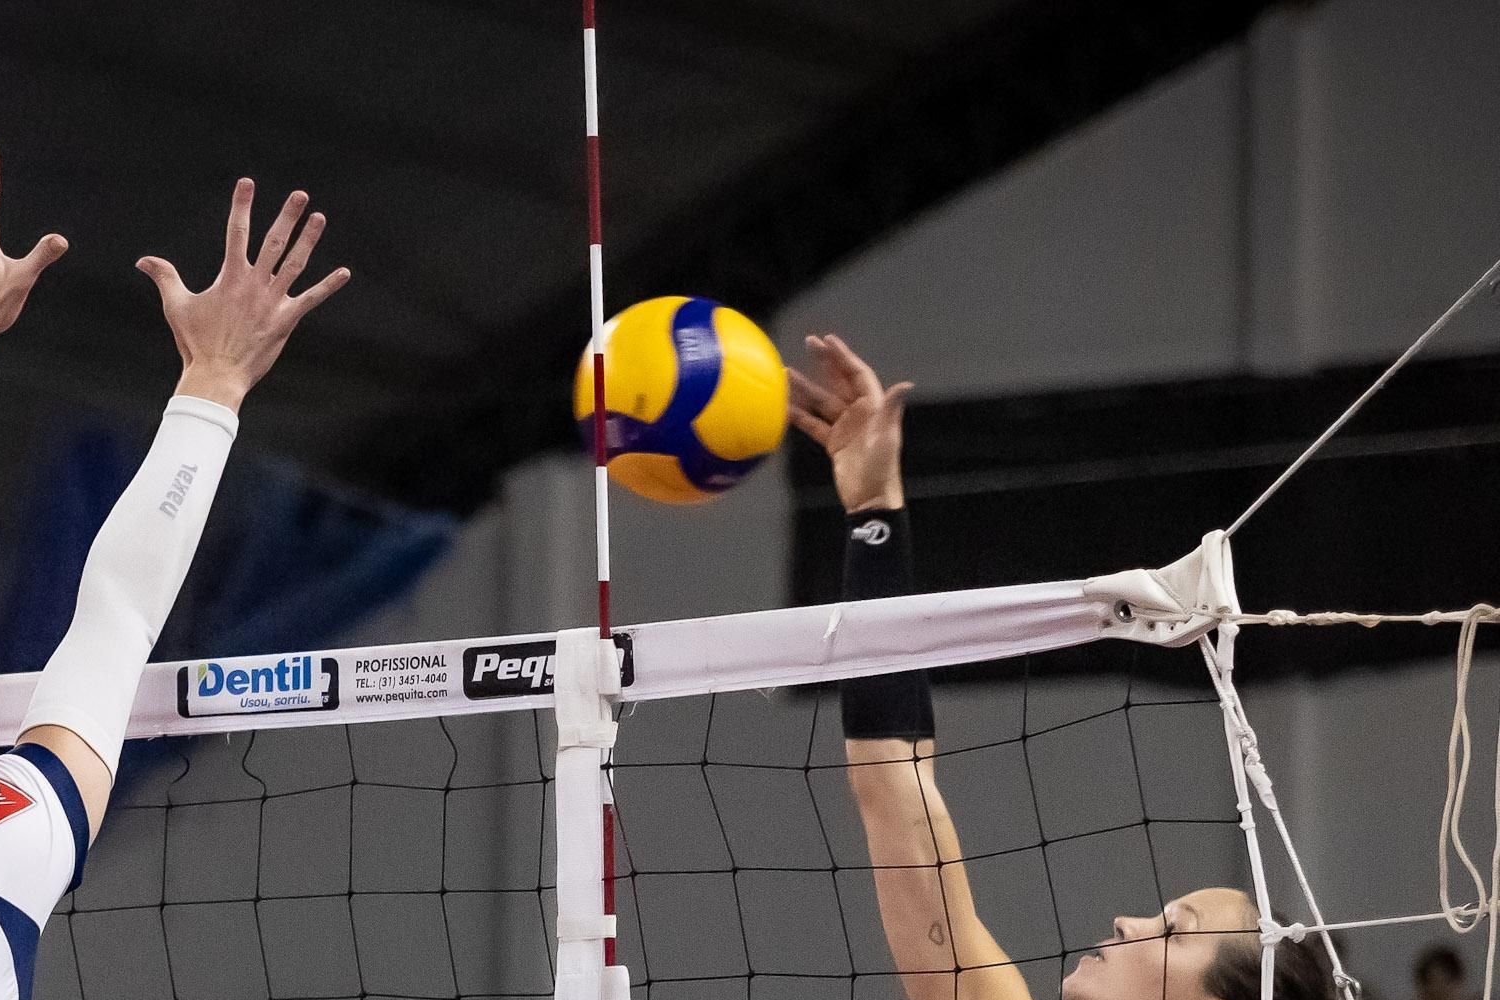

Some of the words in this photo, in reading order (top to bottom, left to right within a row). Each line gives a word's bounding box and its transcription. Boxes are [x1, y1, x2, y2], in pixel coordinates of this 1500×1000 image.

[355, 654, 447, 673] PROFISSIONAL
[197, 655, 312, 697] Dentil
[379, 677, 396, 690] (31)
[398, 672, 447, 686] 3451-4040
[355, 689, 448, 704] www.pequita.com
